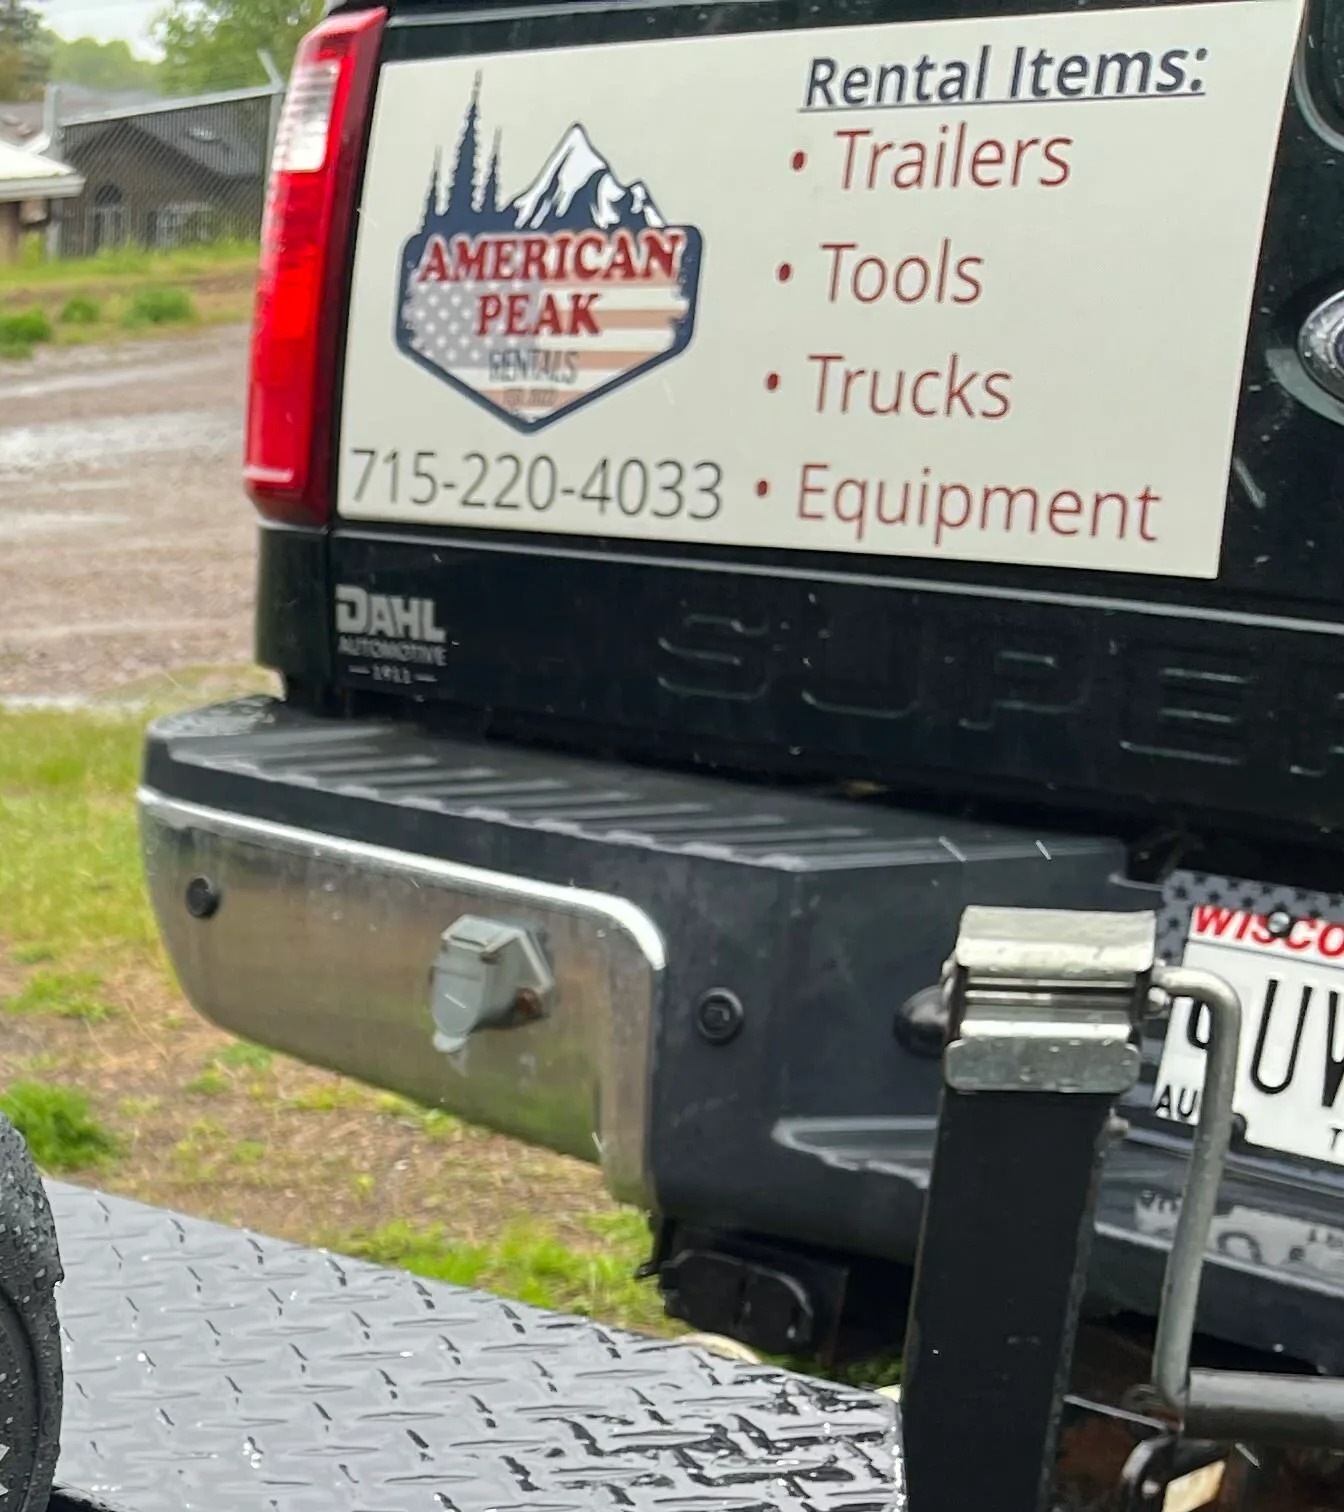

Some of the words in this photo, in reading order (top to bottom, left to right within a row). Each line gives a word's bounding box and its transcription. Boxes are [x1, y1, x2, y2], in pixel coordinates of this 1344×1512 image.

[804, 45, 992, 107] Rental
[1009, 46, 1209, 99] Items:
[834, 122, 1074, 190] Trailers
[417, 233, 684, 282] AMERICAN
[820, 238, 985, 304] Tools
[477, 293, 603, 337] PEAK
[488, 351, 580, 384] RENTALS
[808, 353, 1012, 418] Trucks
[351, 448, 723, 519] 715-220-4033
[796, 464, 1162, 547] Equipment
[335, 584, 446, 643] DAHL
[338, 636, 448, 666] AUTOMOTIVE
[1155, 1084, 1199, 1118] AU
